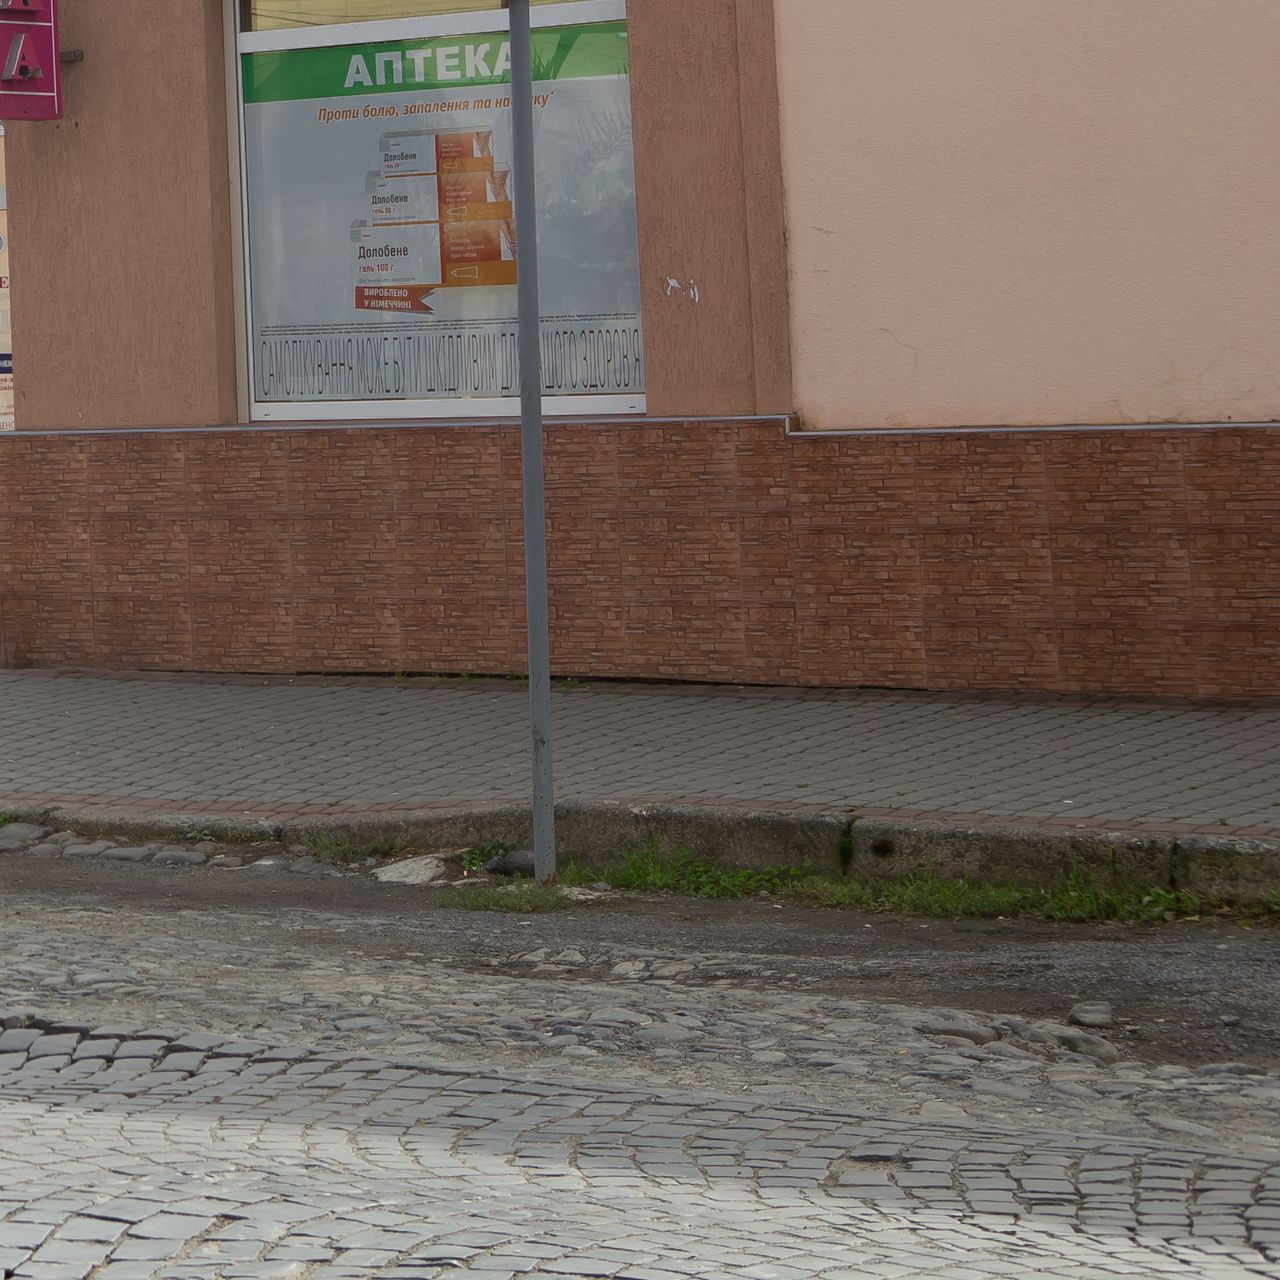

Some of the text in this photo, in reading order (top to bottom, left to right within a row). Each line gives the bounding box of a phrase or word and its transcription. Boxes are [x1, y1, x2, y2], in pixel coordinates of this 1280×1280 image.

[318, 107, 359, 124] Проти
[363, 104, 400, 119] болю,
[402, 101, 469, 115] запалення
[472, 99, 491, 110] та
[371, 193, 409, 205] Долобене
[358, 245, 409, 260] Долобене
[376, 263, 389, 272] 100
[363, 288, 409, 297] ВИРОБЛЕНО
[363, 299, 412, 309] У НІМЕЧЧИНІ
[261, 339, 354, 396] САМОЛІКУВАННЯ
[356, 337, 391, 394] МОЖЕ
[393, 336, 423, 393] БУТИ
[425, 333, 498, 399] ШКІДЛИВИМ
